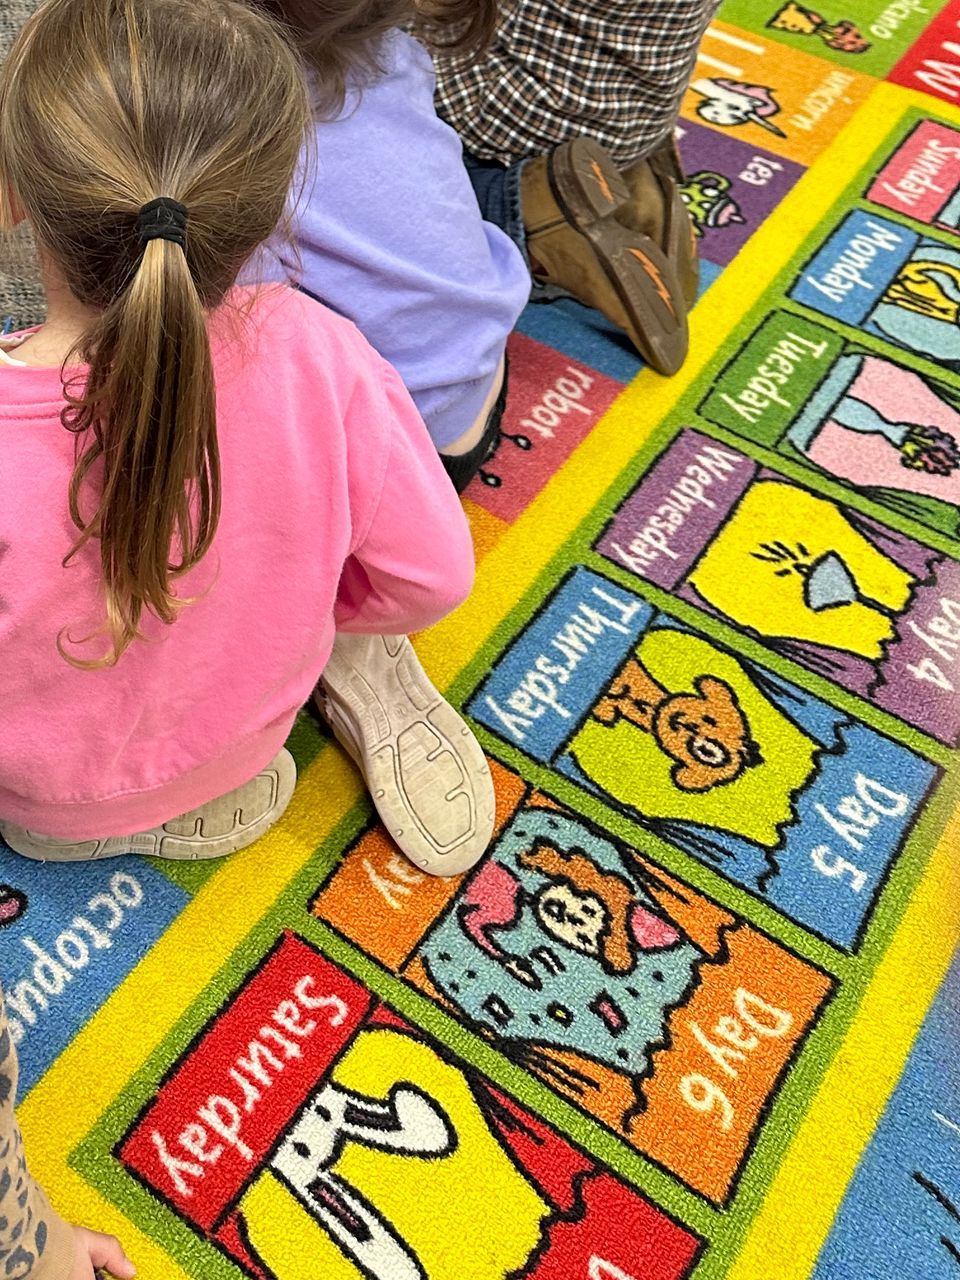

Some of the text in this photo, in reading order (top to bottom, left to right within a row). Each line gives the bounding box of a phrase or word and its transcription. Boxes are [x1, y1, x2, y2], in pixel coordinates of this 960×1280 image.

[787, 71, 855, 132] unicorn
[738, 156, 784, 186] tea
[881, 139, 960, 206] Sunday
[819, 219, 903, 303] Monday
[518, 366, 596, 440] robot
[723, 325, 830, 423] Tuesday
[610, 445, 743, 575] Wednesday
[484, 587, 642, 740] Thursday
[906, 658, 955, 691] 4
[810, 773, 910, 891] Day 5
[150, 974, 350, 1196] Saturday
[677, 987, 793, 1131] Day 6
